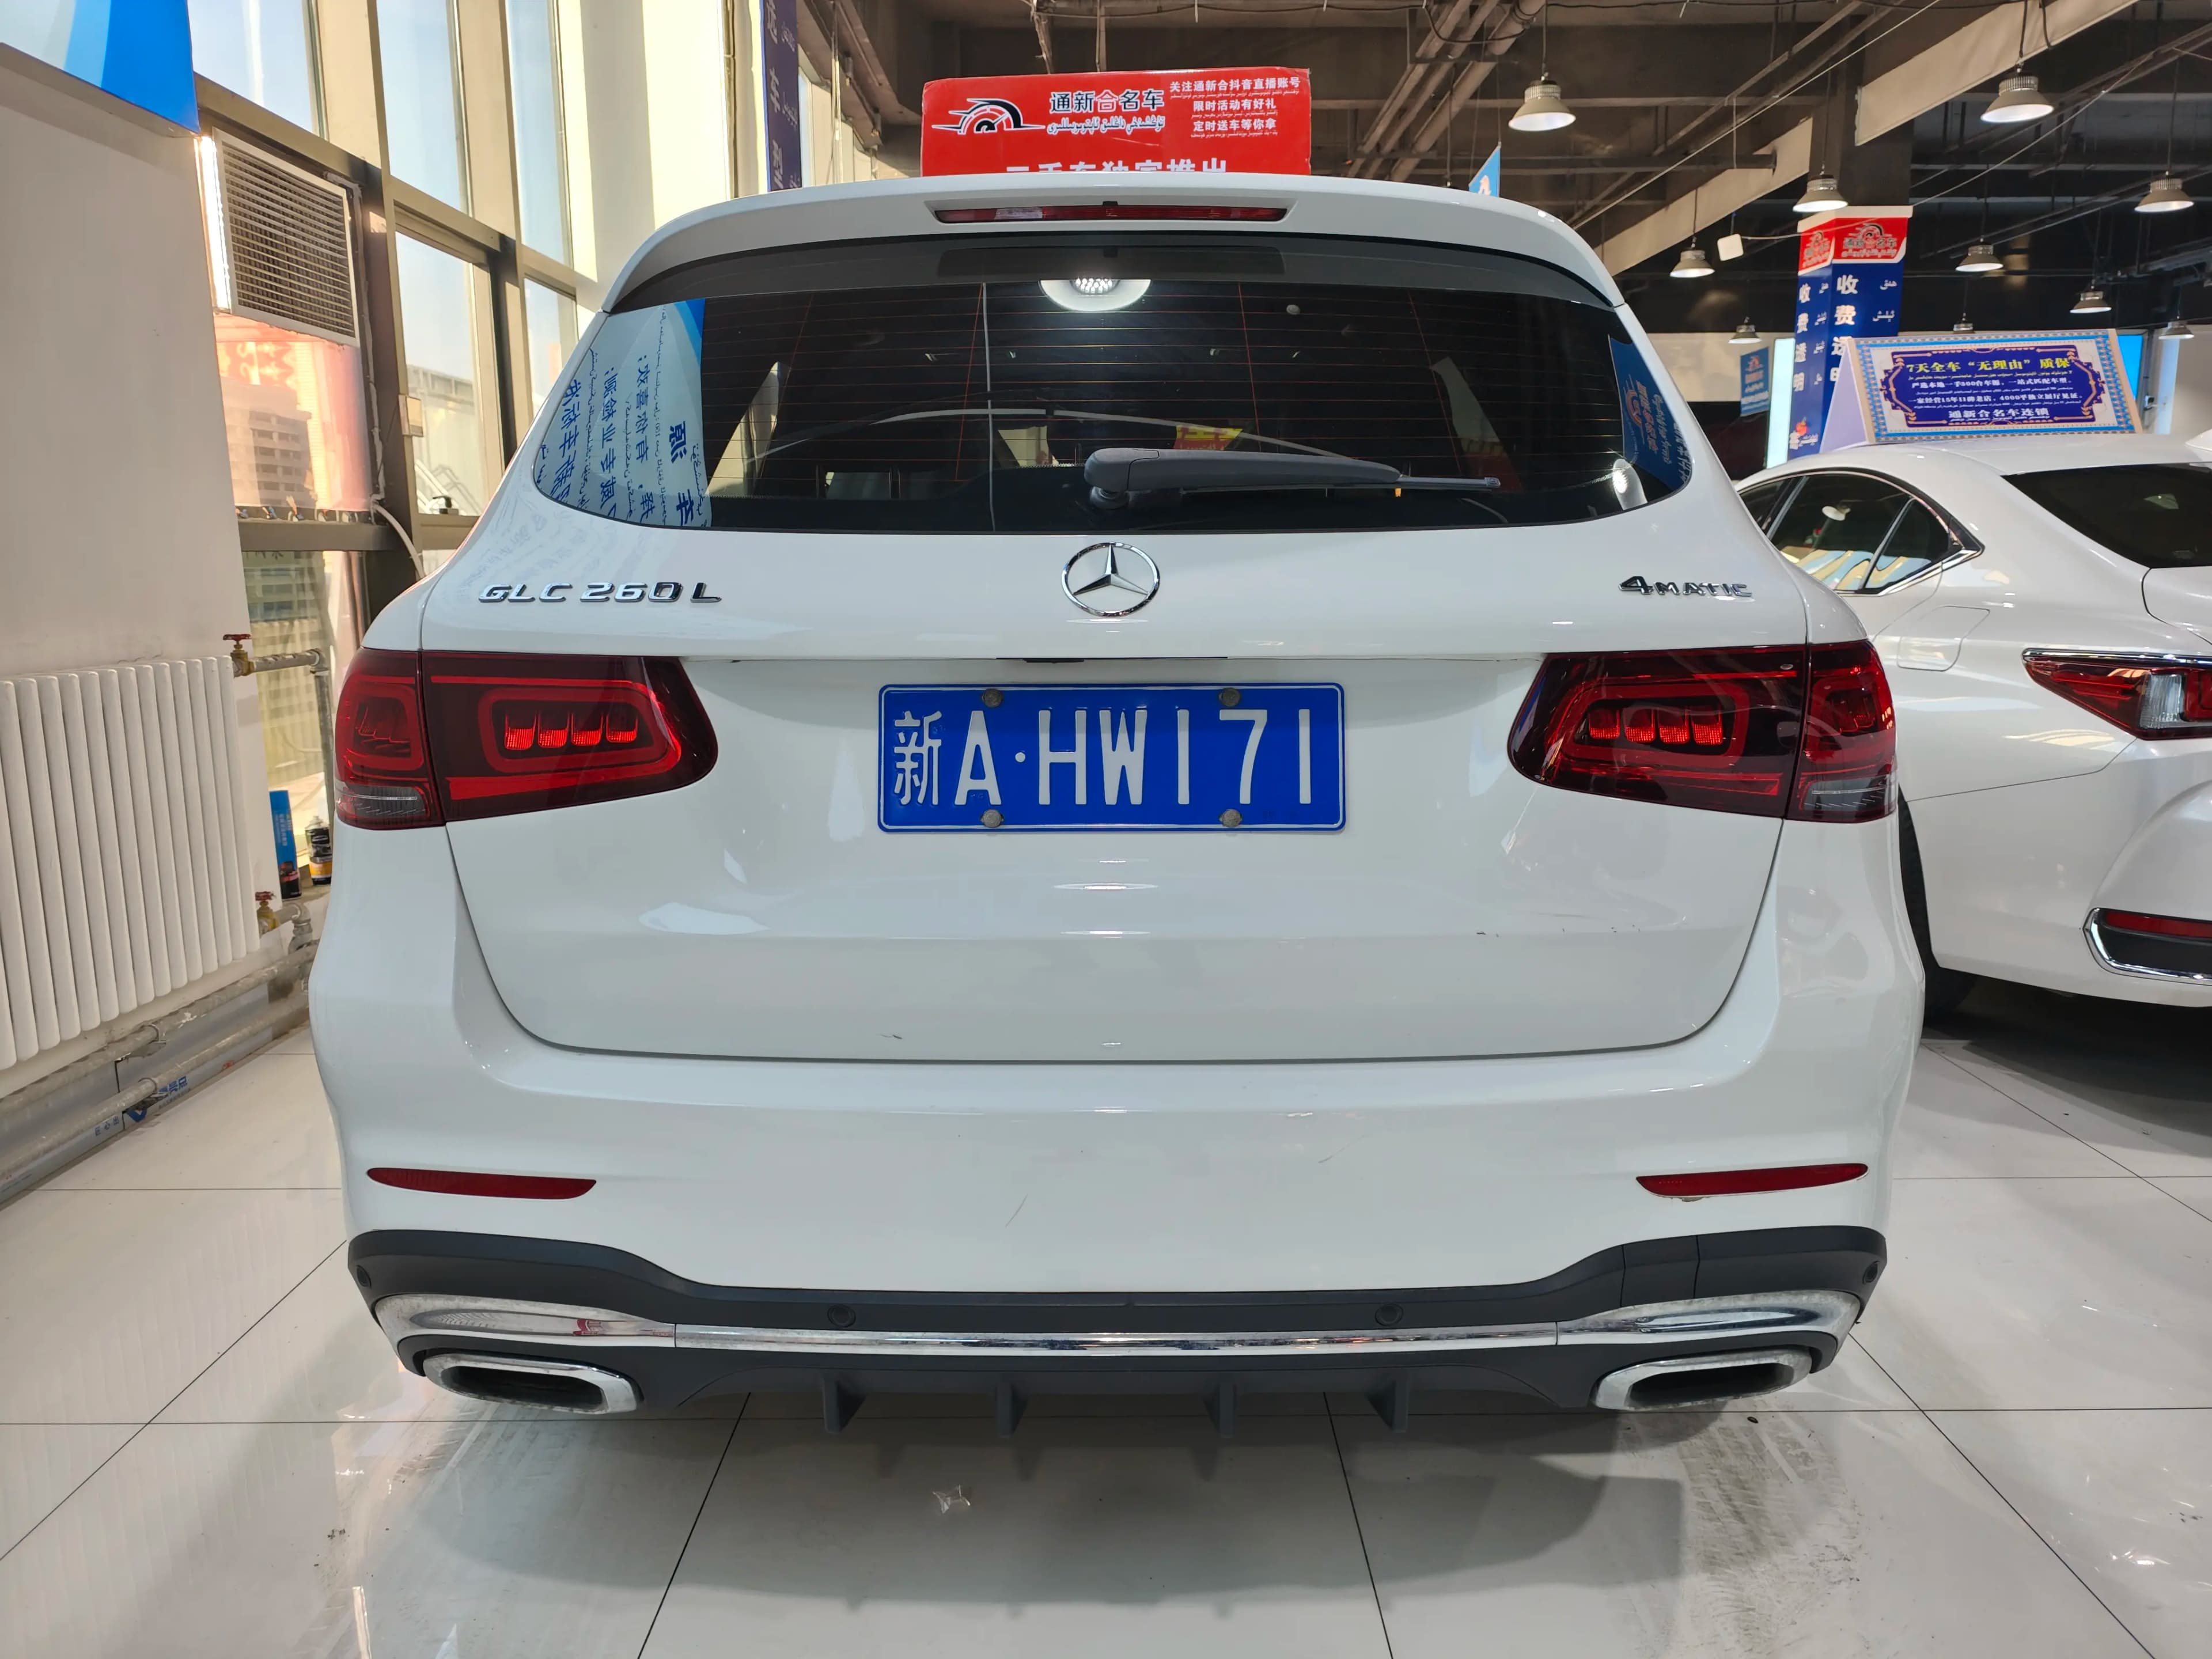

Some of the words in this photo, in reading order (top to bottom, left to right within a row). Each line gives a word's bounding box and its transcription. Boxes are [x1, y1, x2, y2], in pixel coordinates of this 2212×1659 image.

[1170, 77, 1301, 93] 关注通新合抖音直播账号
[1050, 89, 1164, 114] 通新合名车
[1193, 98, 1277, 112] 限时活动有好礼
[1193, 118, 1277, 132] 定时送车等你拿
[478, 583, 573, 603] GLC
[579, 582, 683, 603] 260
[691, 582, 722, 603] L
[1618, 575, 1753, 597] 4MATIC
